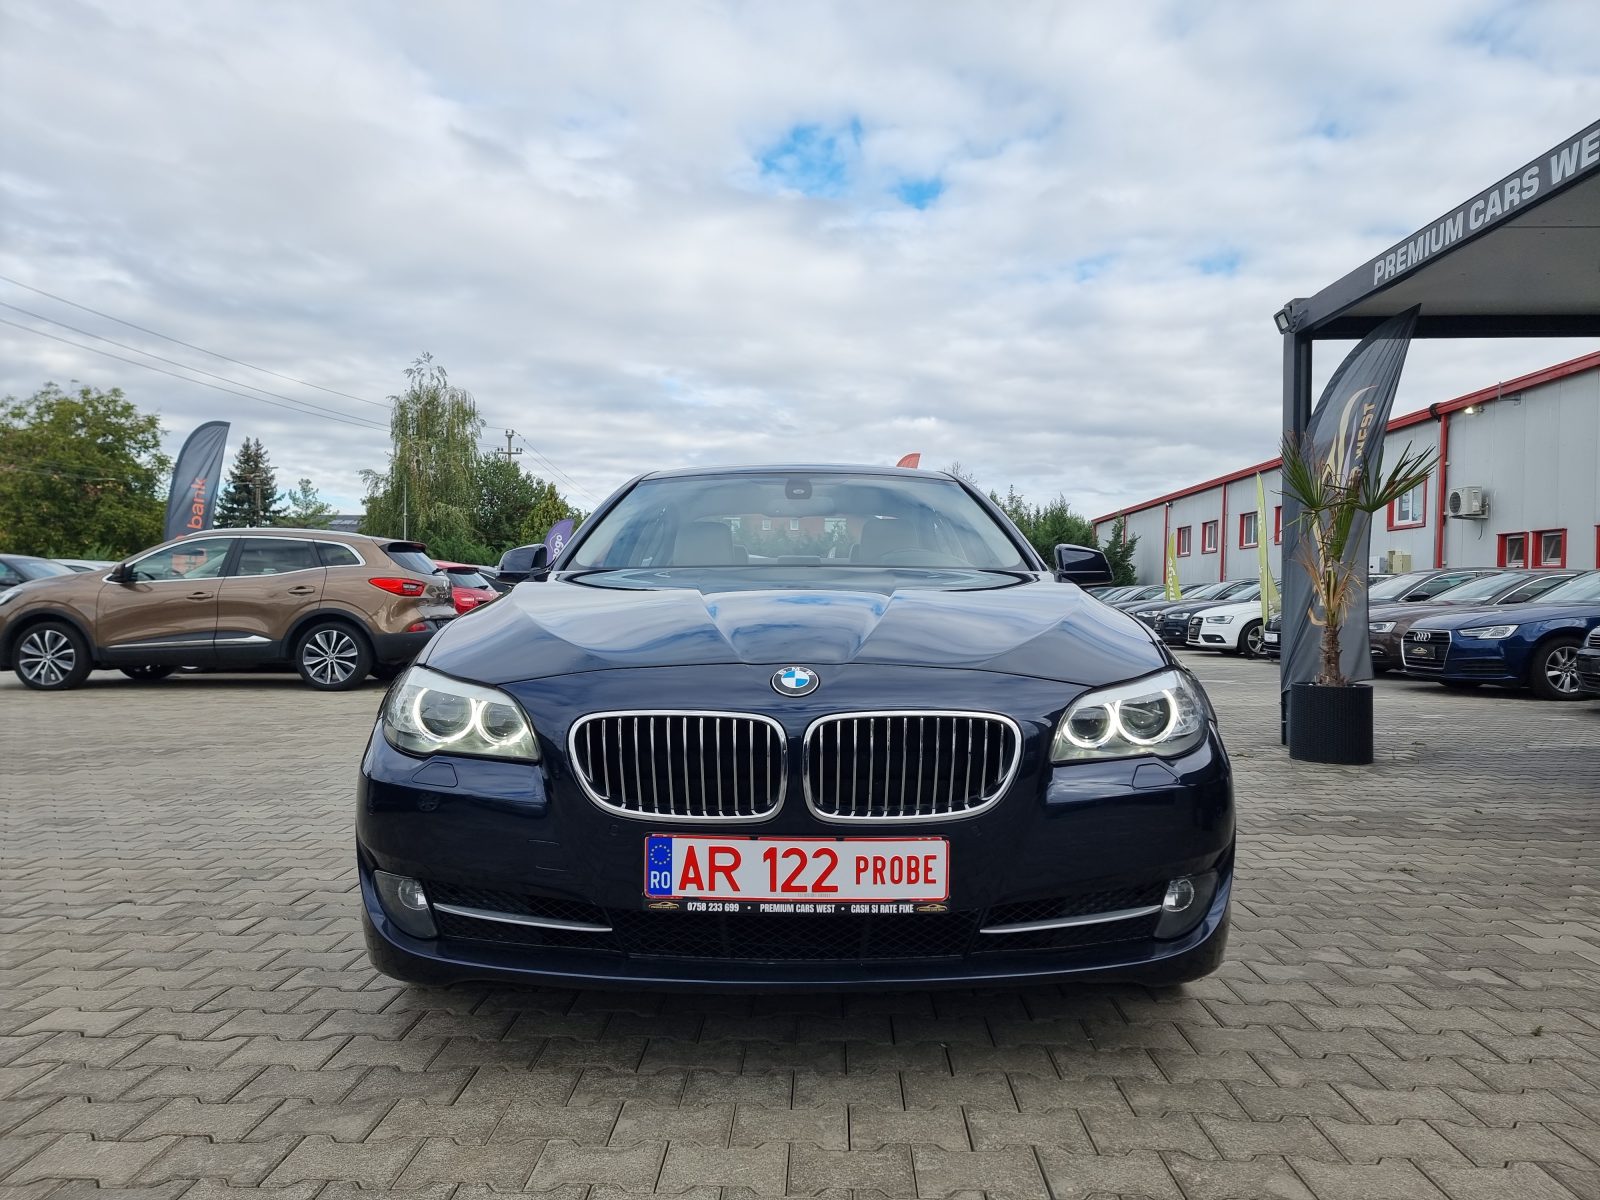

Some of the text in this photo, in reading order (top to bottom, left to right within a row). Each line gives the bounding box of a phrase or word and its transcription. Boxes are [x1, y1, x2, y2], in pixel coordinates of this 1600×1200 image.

[1373, 128, 1600, 286] PREMIUM CARS WE
[1355, 403, 1376, 461] WEST
[187, 477, 208, 529] bank
[650, 870, 671, 889] RO
[678, 845, 937, 893] AR 122 PROBE
[687, 902, 706, 911] 0758
[708, 902, 722, 912] 233
[724, 903, 739, 912] 699
[760, 903, 794, 913] PREMIUM
[795, 903, 815, 913] CARS
[816, 904, 835, 913] WEST
[850, 904, 869, 914] CASH
[871, 904, 878, 914] SI
[880, 904, 897, 914] RATE
[899, 904, 914, 913] FIXE
